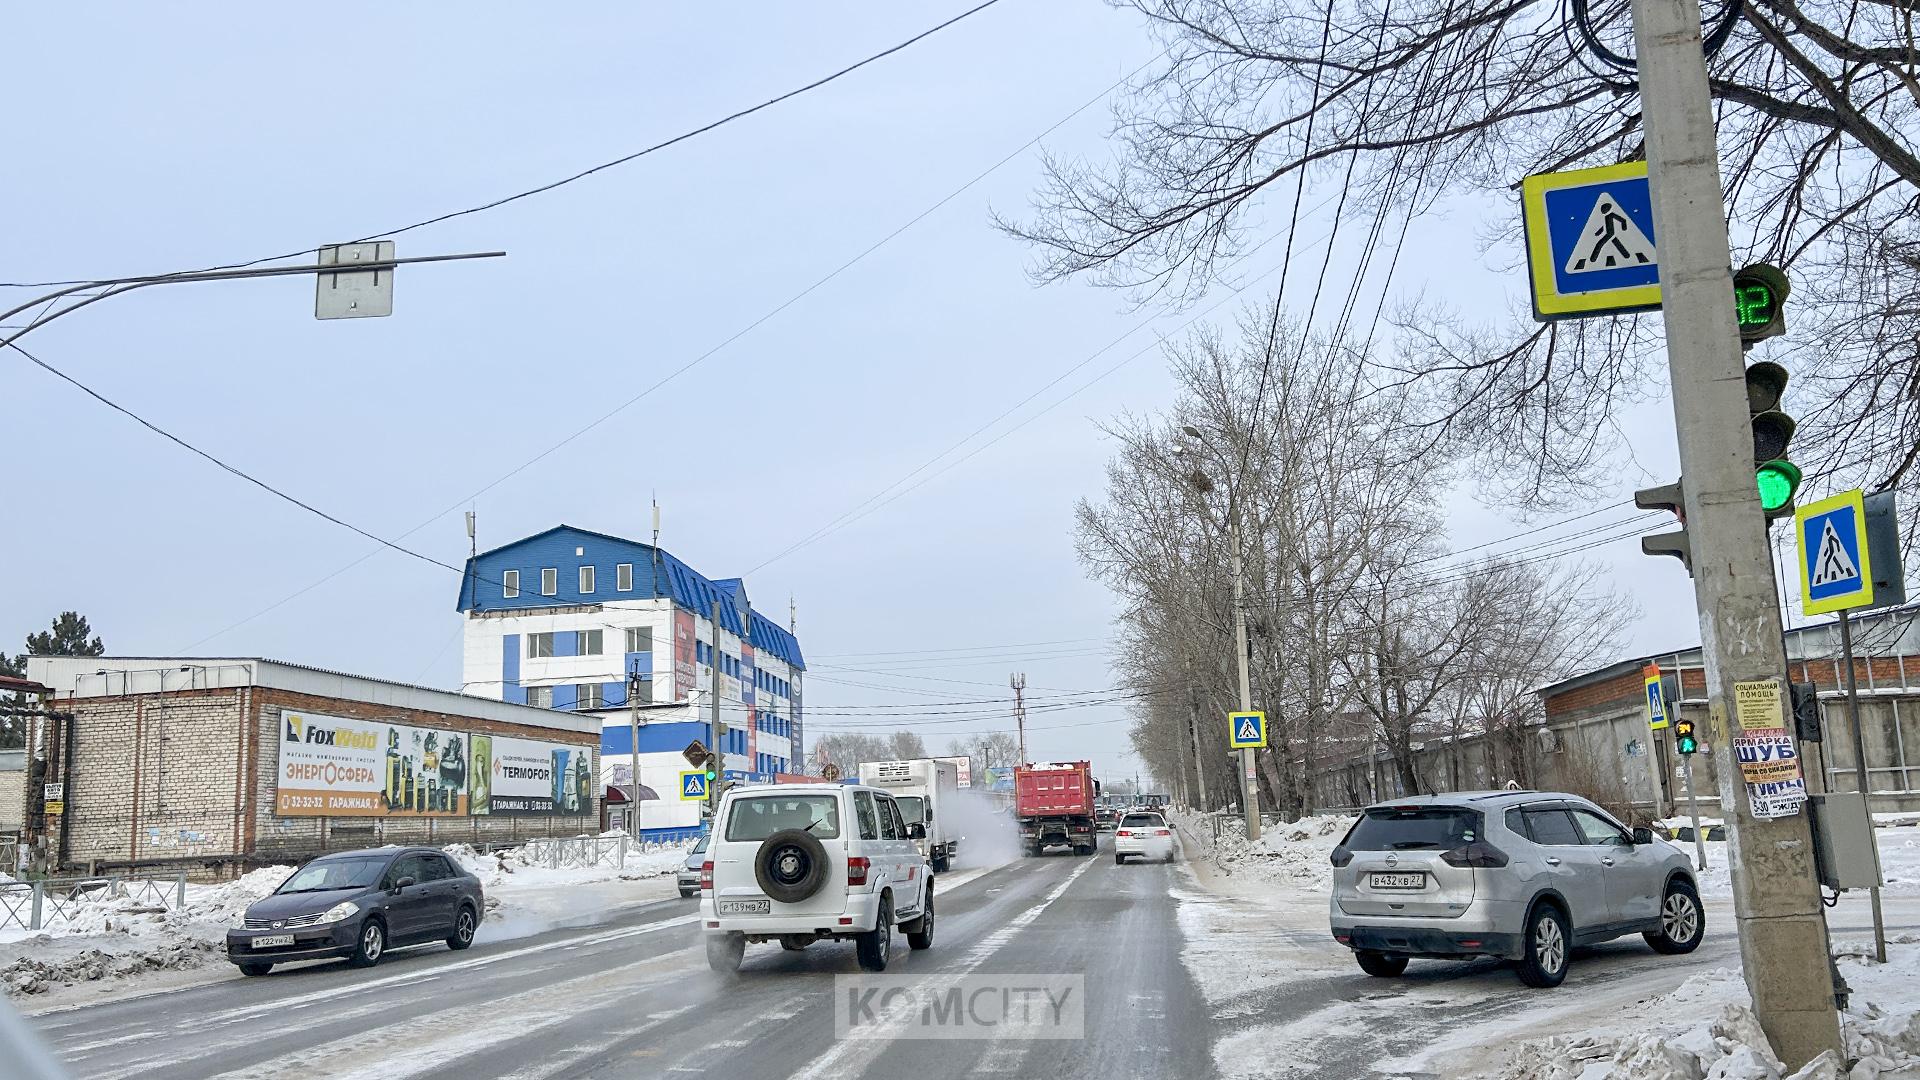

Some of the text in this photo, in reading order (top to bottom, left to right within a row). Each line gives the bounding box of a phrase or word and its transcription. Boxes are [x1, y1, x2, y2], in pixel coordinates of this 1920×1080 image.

[1735, 683, 1778, 692] СОЦИАЛЬНАЯ
[1740, 690, 1774, 698] ПОМОЩЬ
[1734, 737, 1792, 747] ЯРМАРКА
[1735, 745, 1796, 763] ШУБ
[286, 761, 375, 786] ЭНЕРГОСФЕРА
[503, 767, 550, 780] TERMOFOR
[291, 796, 379, 810] 32-32-32 ГАРАЖНАЯ, 2
